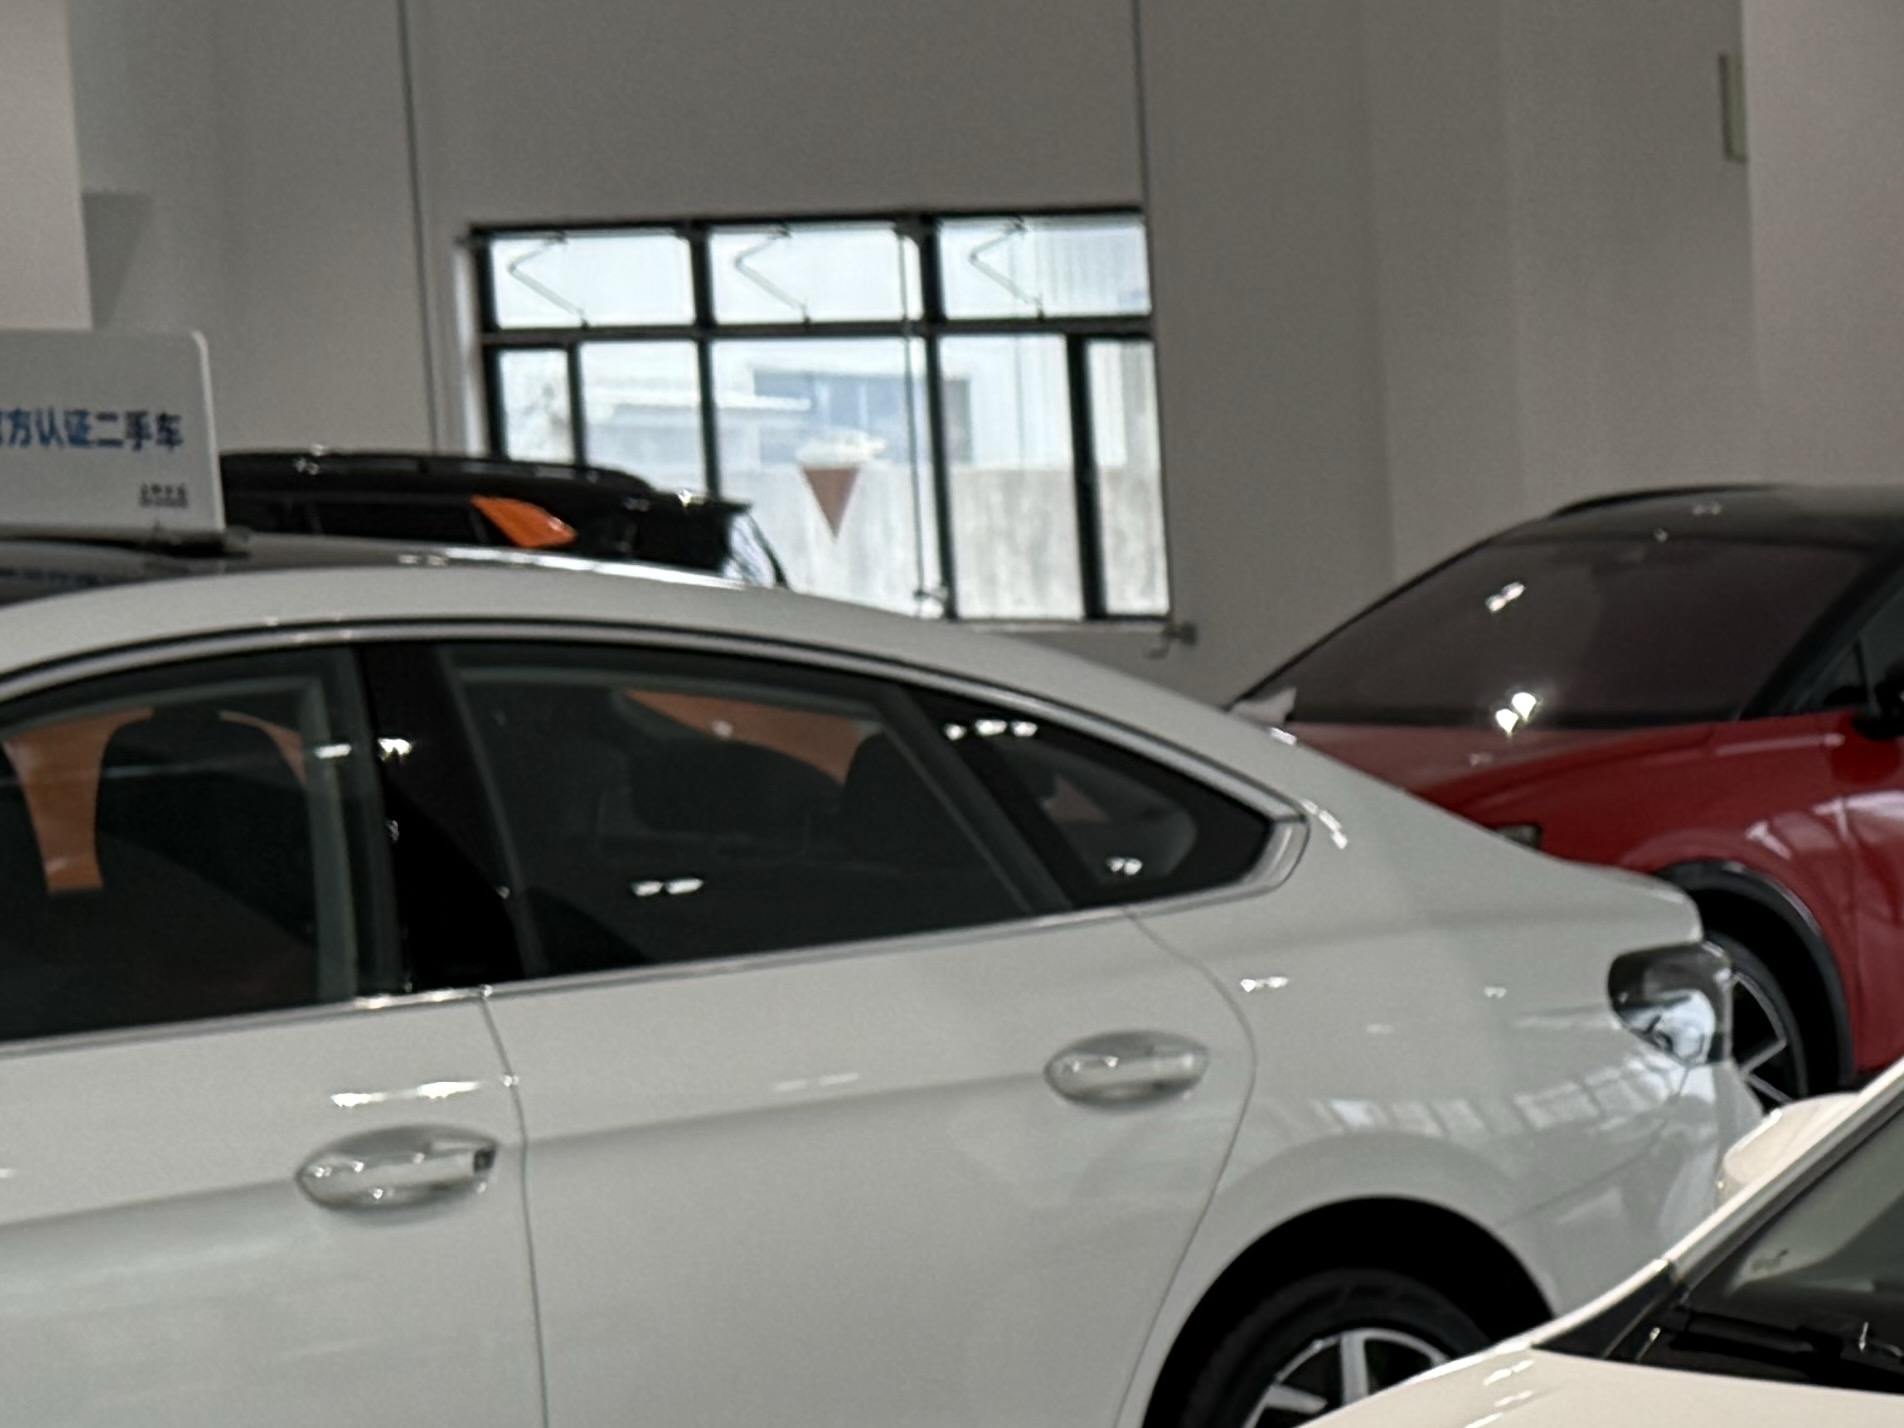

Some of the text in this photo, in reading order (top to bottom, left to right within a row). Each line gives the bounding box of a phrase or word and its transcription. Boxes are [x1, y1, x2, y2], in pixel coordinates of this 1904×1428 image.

[0, 404, 185, 452] 方认证二手车
